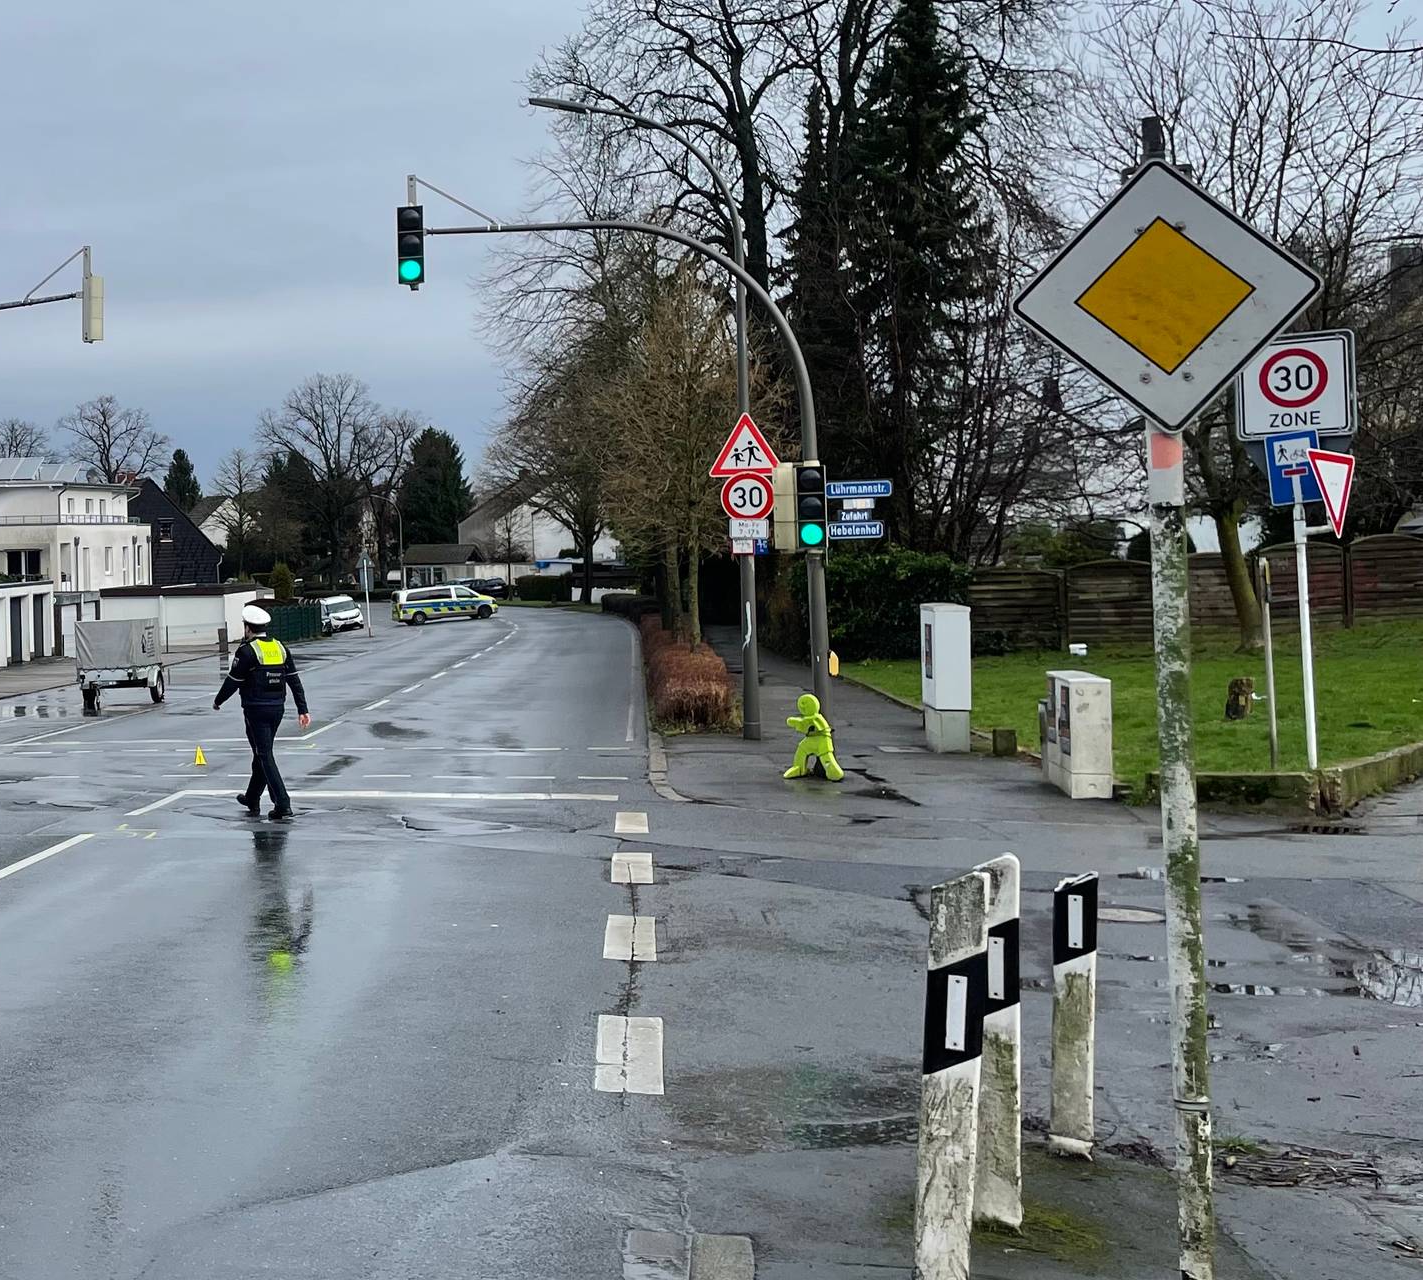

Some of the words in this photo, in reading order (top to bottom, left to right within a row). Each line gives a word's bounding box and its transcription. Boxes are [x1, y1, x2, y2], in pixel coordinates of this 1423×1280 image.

[1274, 364, 1313, 392] 30
[1269, 410, 1321, 428] ZONE
[733, 486, 762, 508] 30
[841, 511, 868, 520] Zufahrt
[830, 524, 880, 536] Hebelenhof
